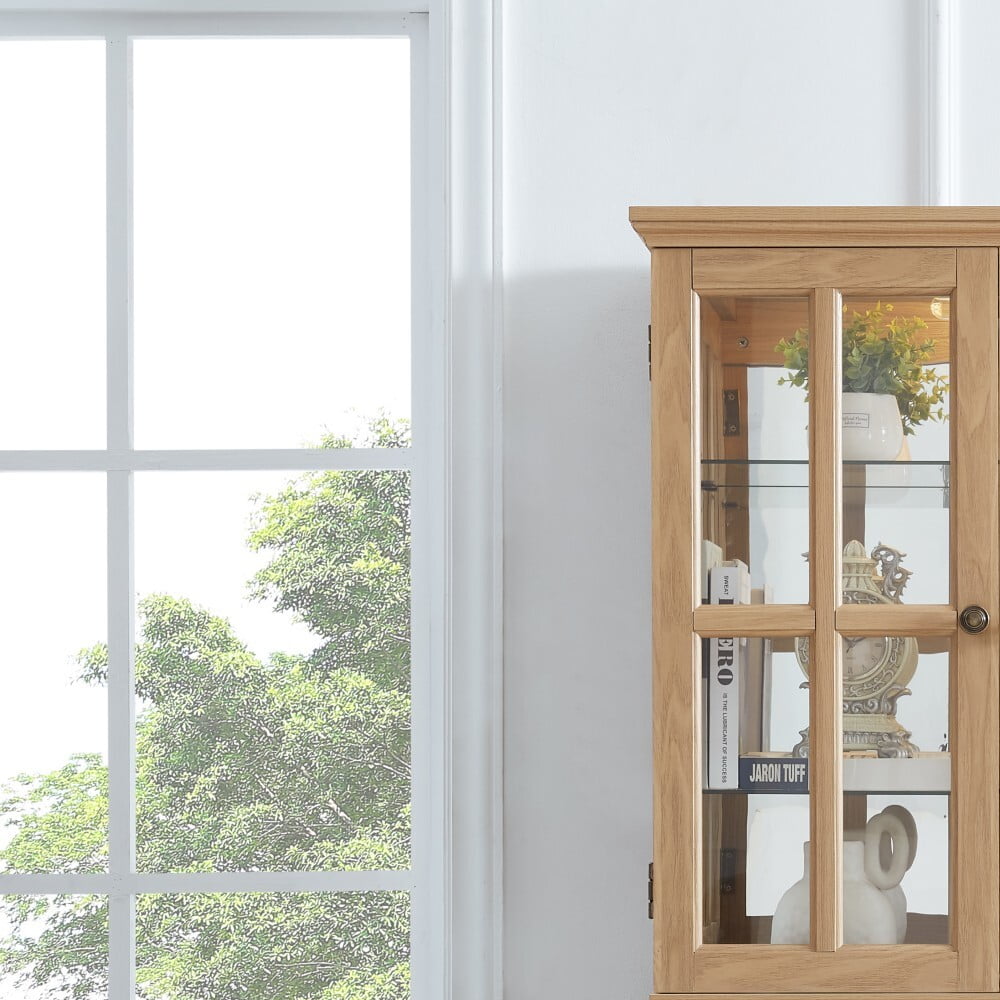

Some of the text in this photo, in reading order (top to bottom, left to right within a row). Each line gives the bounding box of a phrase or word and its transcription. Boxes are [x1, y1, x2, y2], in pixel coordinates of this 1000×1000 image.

[722, 746, 728, 754] OF
[749, 763, 806, 783] JARON TUFF
